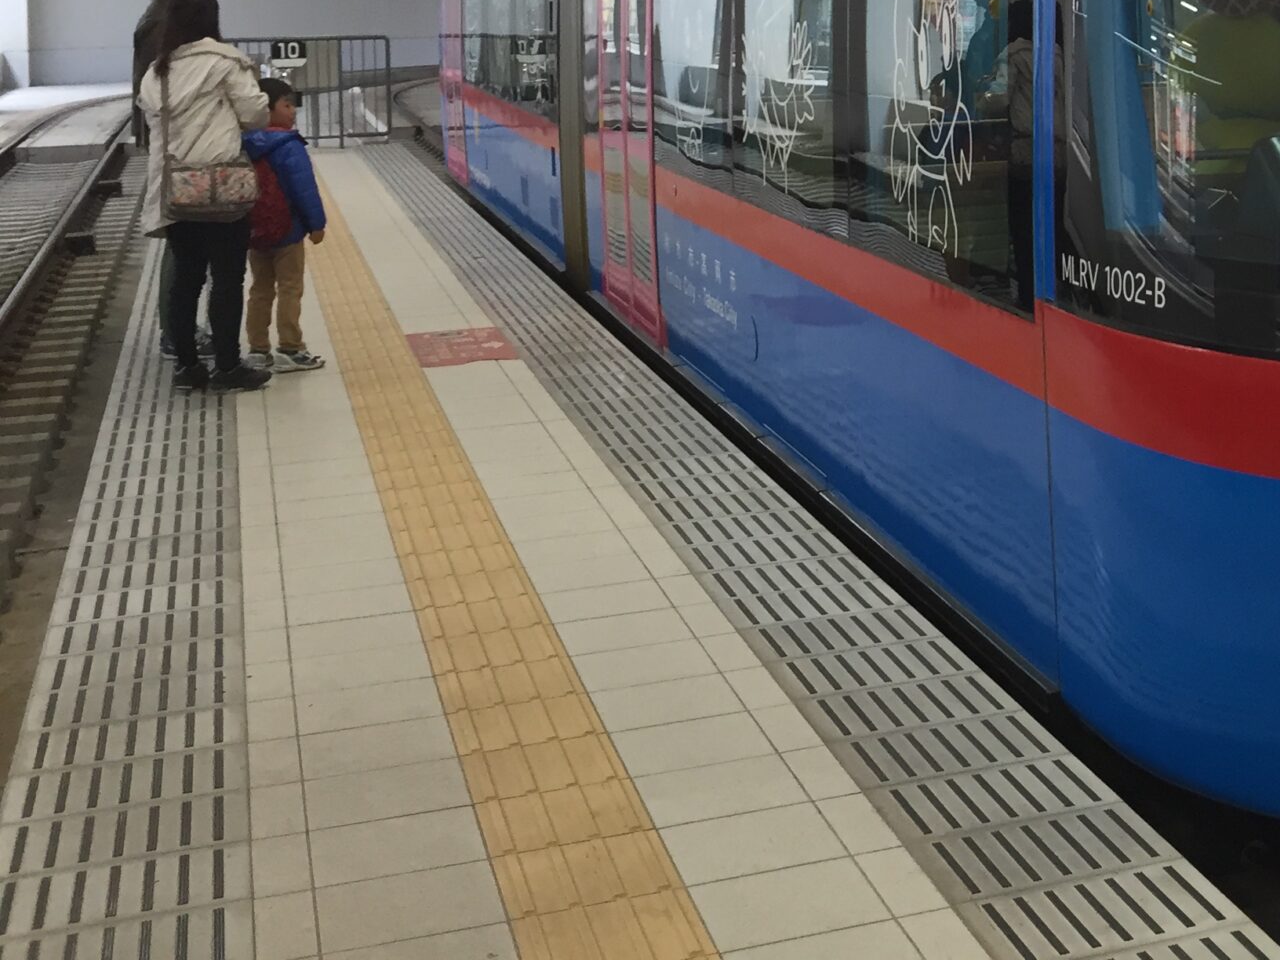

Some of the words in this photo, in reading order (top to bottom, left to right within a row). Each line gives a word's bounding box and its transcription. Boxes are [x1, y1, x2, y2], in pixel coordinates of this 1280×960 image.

[277, 42, 300, 59] 10
[1061, 252, 1100, 292] MLRV
[1104, 265, 1167, 309] 1002-B
